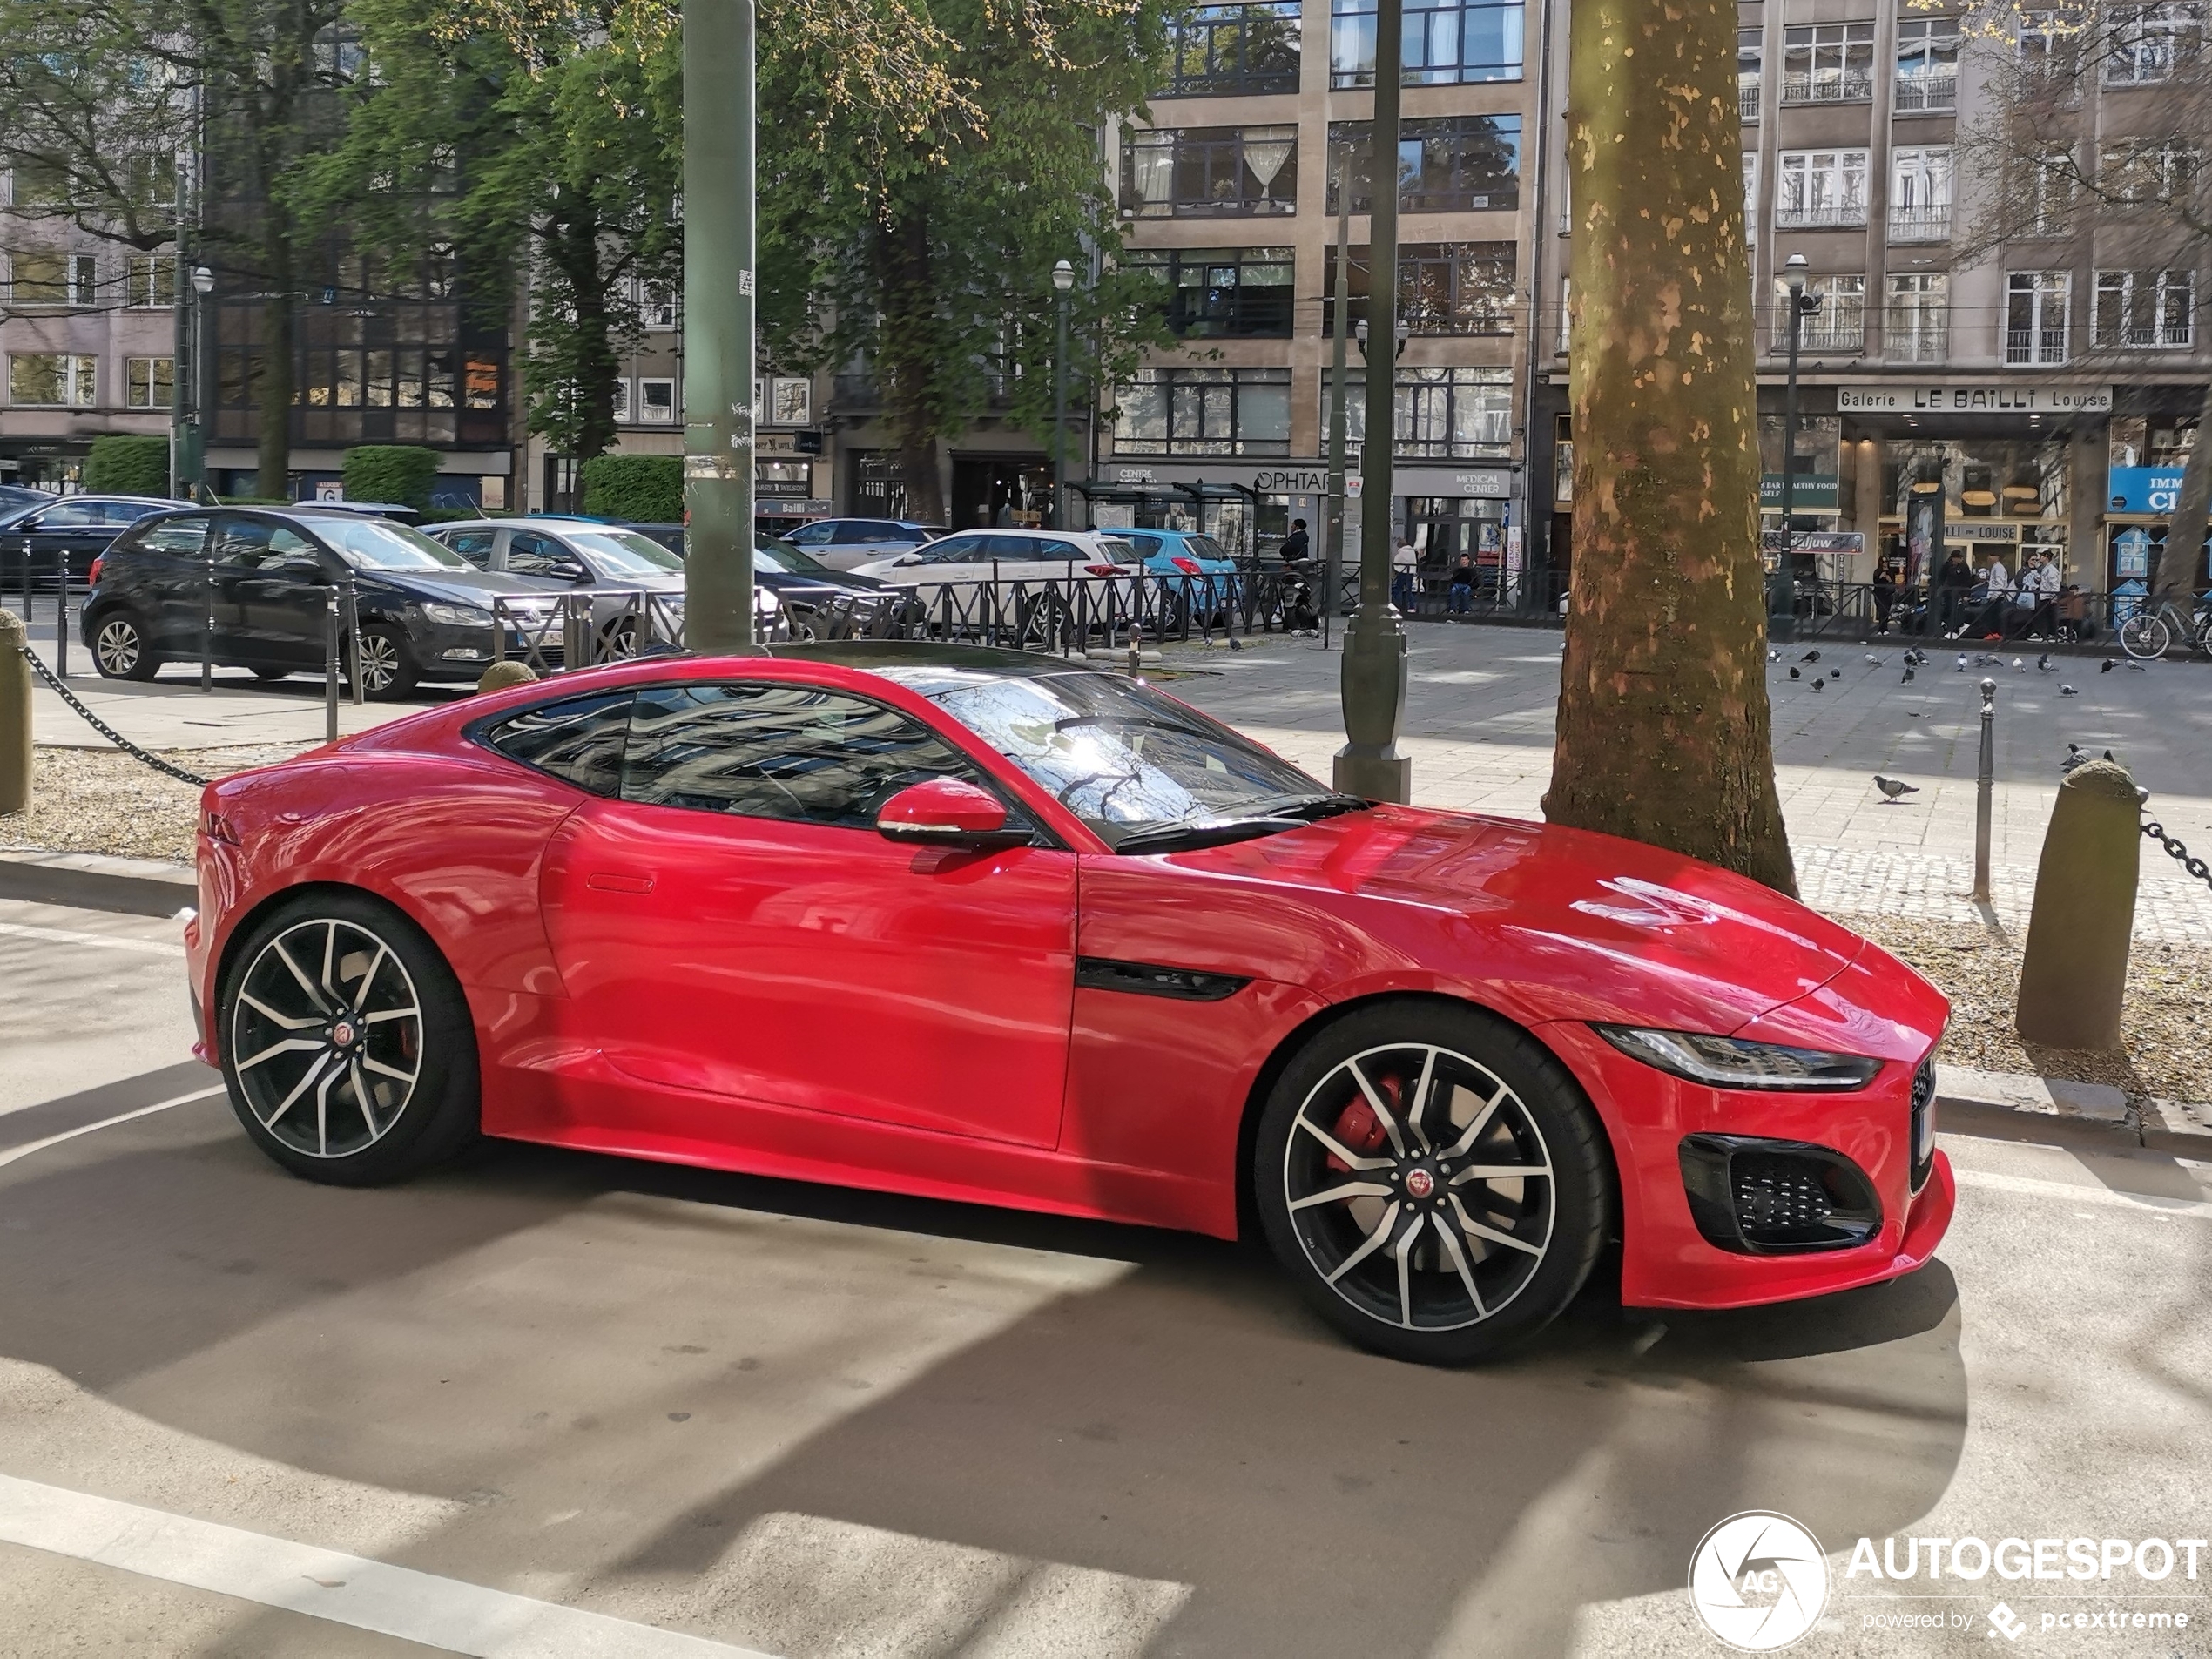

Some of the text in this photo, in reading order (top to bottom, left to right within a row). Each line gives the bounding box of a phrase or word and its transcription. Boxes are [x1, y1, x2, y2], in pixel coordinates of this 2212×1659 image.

[1841, 391, 1895, 407] Galerie
[1914, 389, 1942, 408] LE
[2052, 390, 2107, 407] Louise
[1456, 475, 1499, 484] MEDICAL
[1463, 483, 1500, 494] CENTER
[782, 503, 805, 513] Bailli
[1979, 527, 2015, 538] LOUISE
